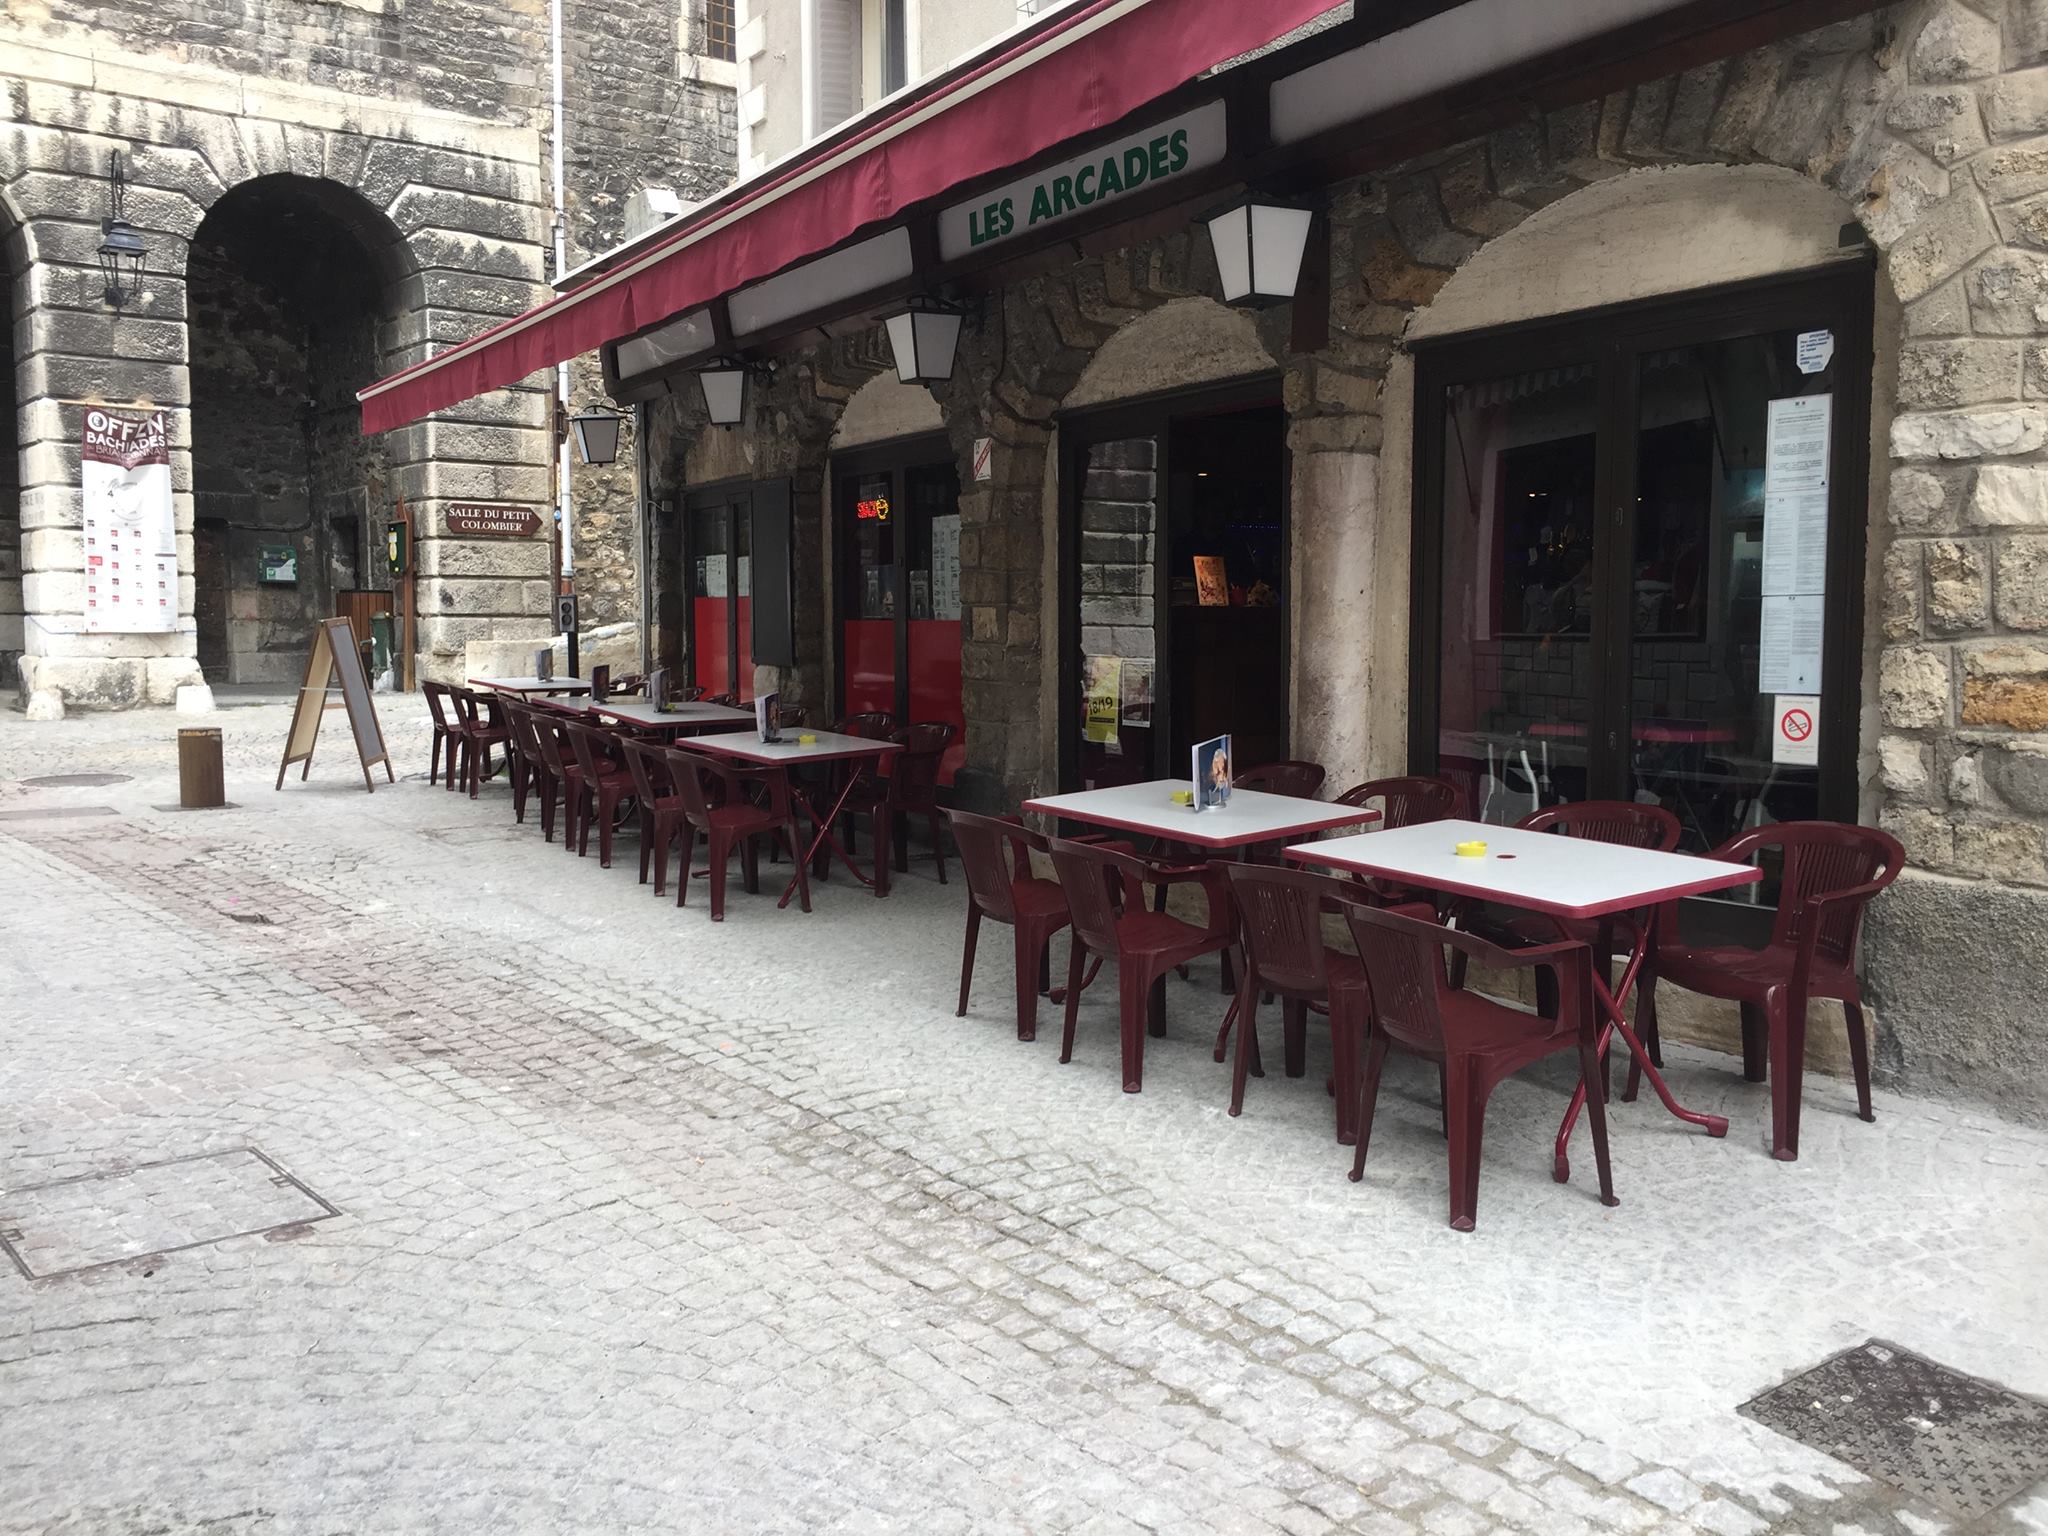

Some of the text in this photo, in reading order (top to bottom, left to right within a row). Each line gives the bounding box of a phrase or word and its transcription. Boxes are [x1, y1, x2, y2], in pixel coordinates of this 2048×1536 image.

[969, 128, 1189, 247] LES ARCADES
[87, 411, 165, 441] OFFEN
[86, 431, 166, 453] BACHIADES
[449, 508, 532, 521] SALLE DU PETIT
[461, 519, 523, 531] COLOMBIER
